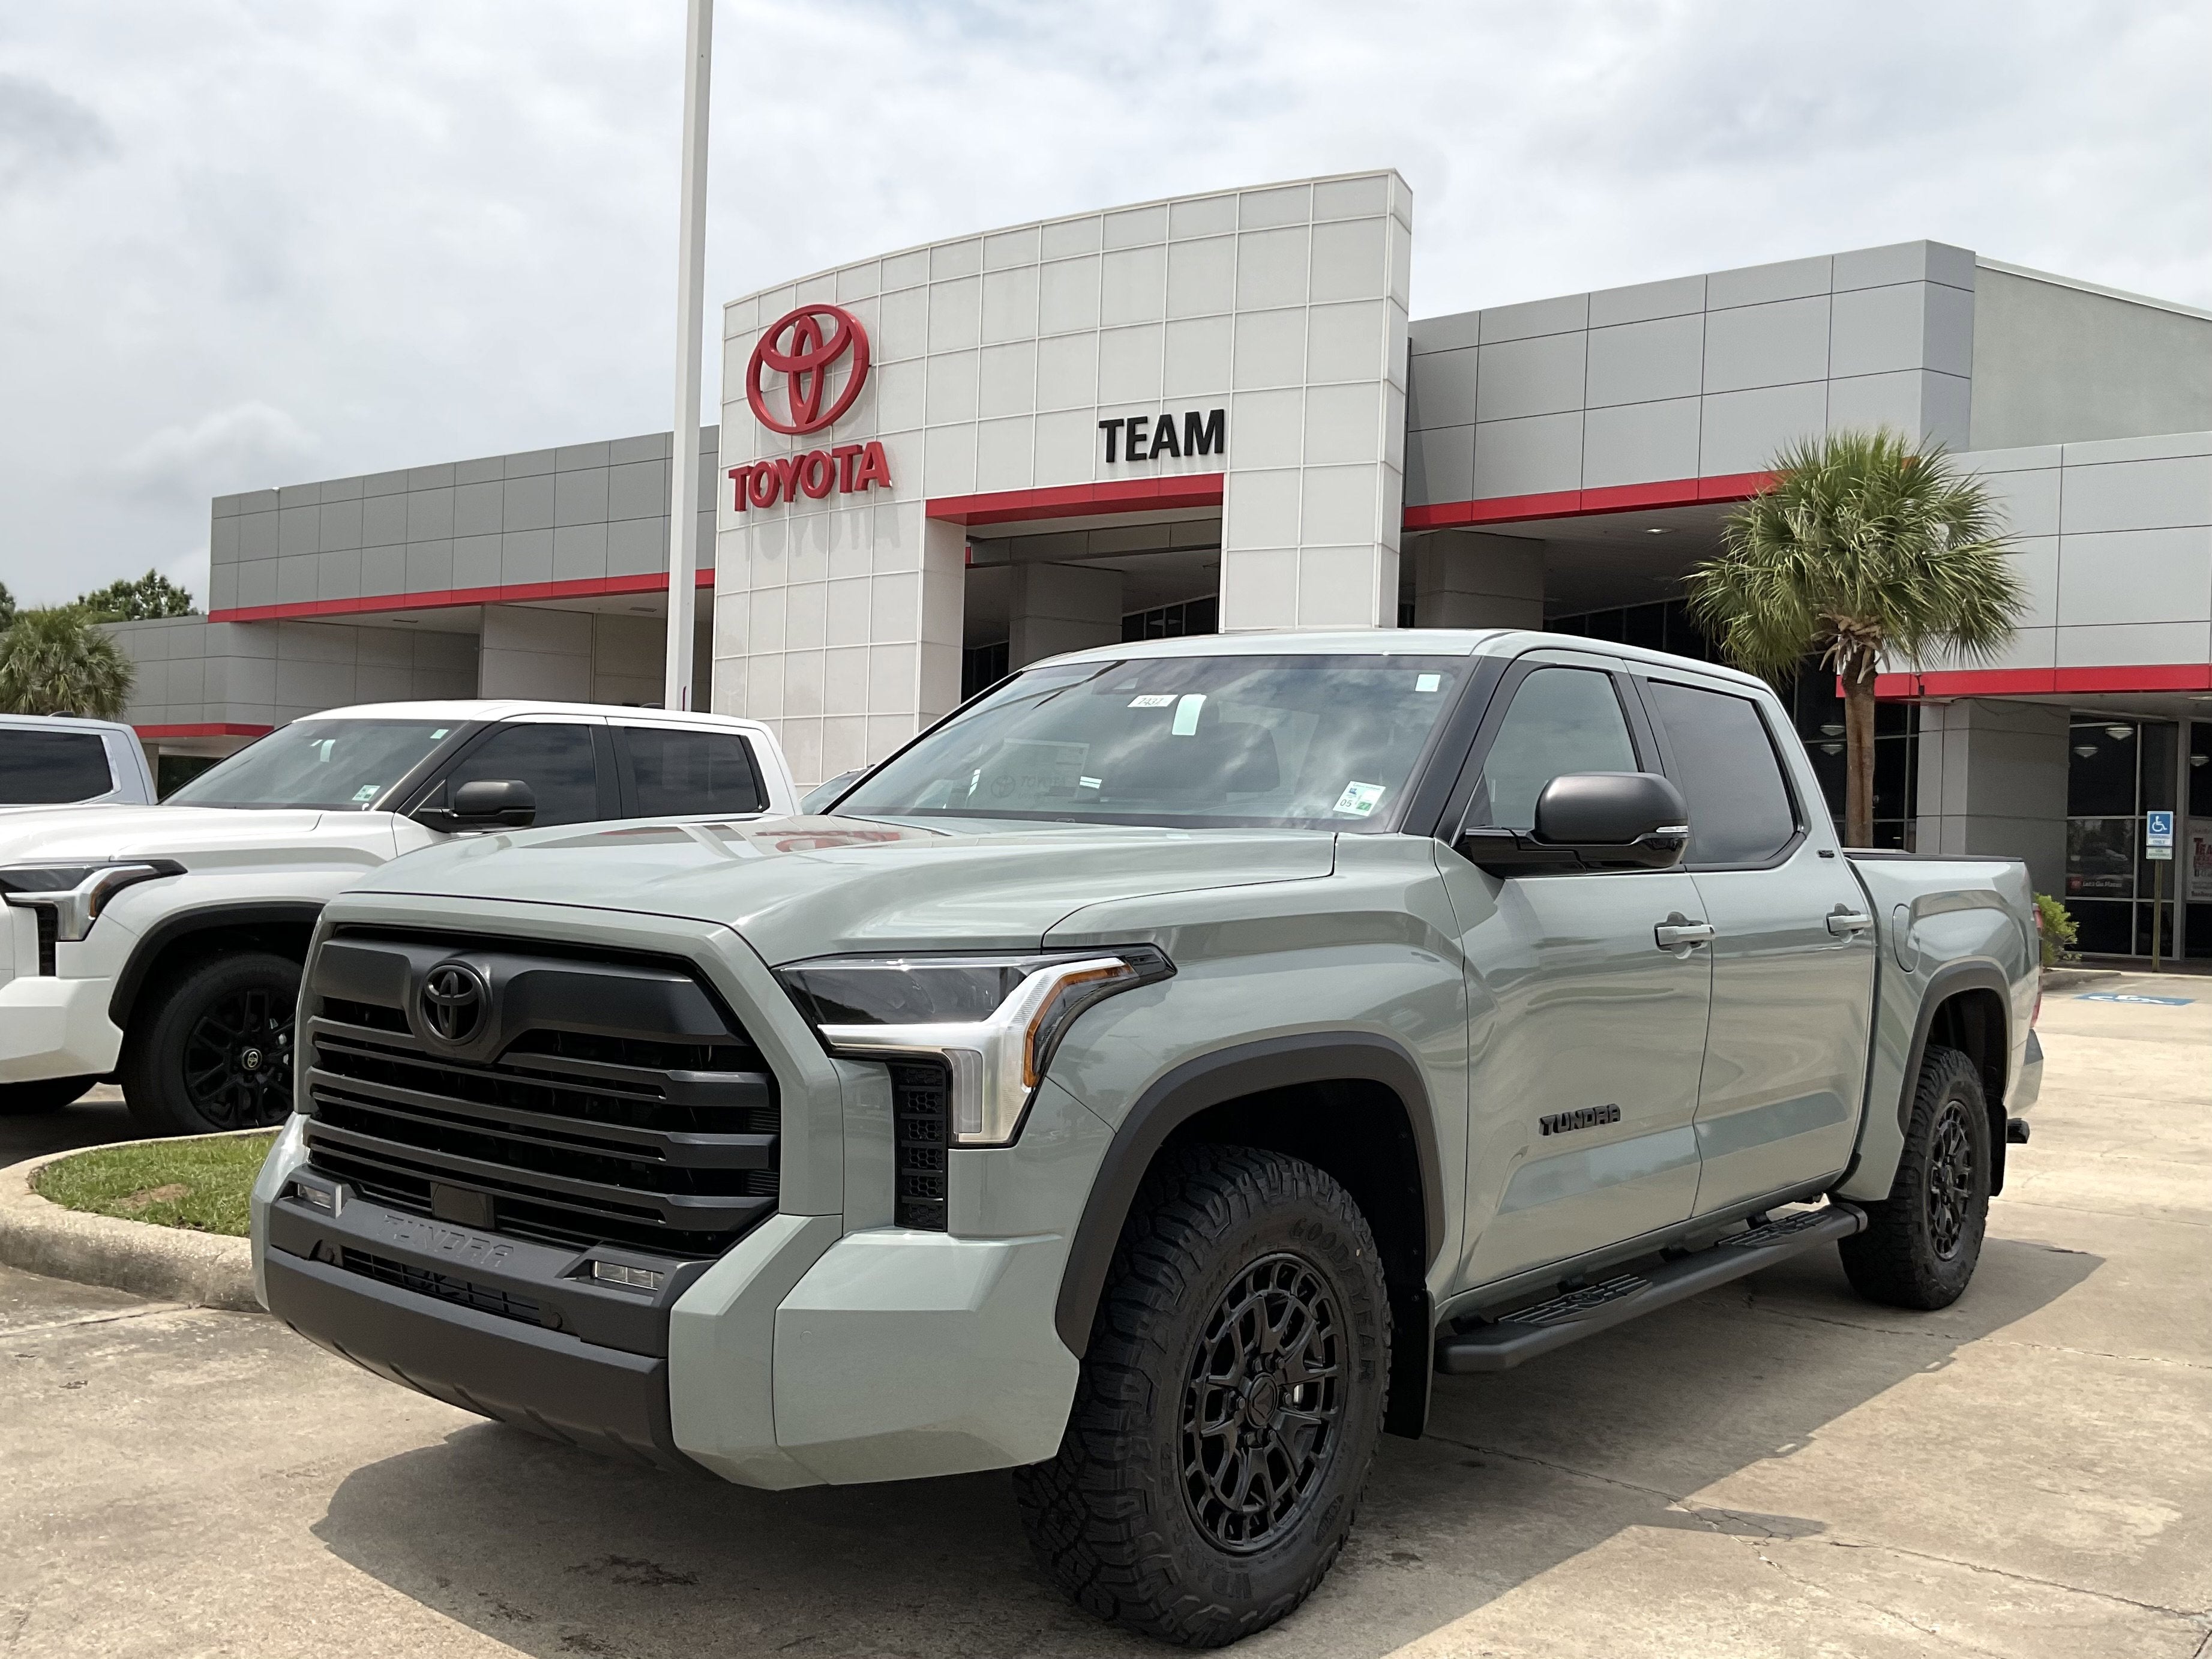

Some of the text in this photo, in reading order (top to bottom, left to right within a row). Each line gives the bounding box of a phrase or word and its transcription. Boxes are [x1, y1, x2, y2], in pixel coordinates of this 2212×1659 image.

[1098, 409, 1225, 463] TEAM
[728, 441, 893, 512] TOYOTA
[1340, 799, 1353, 807] 05
[1356, 801, 1372, 810] 27
[1539, 1103, 1621, 1136] TUNDRA
[377, 1214, 514, 1268] TUNDRA
